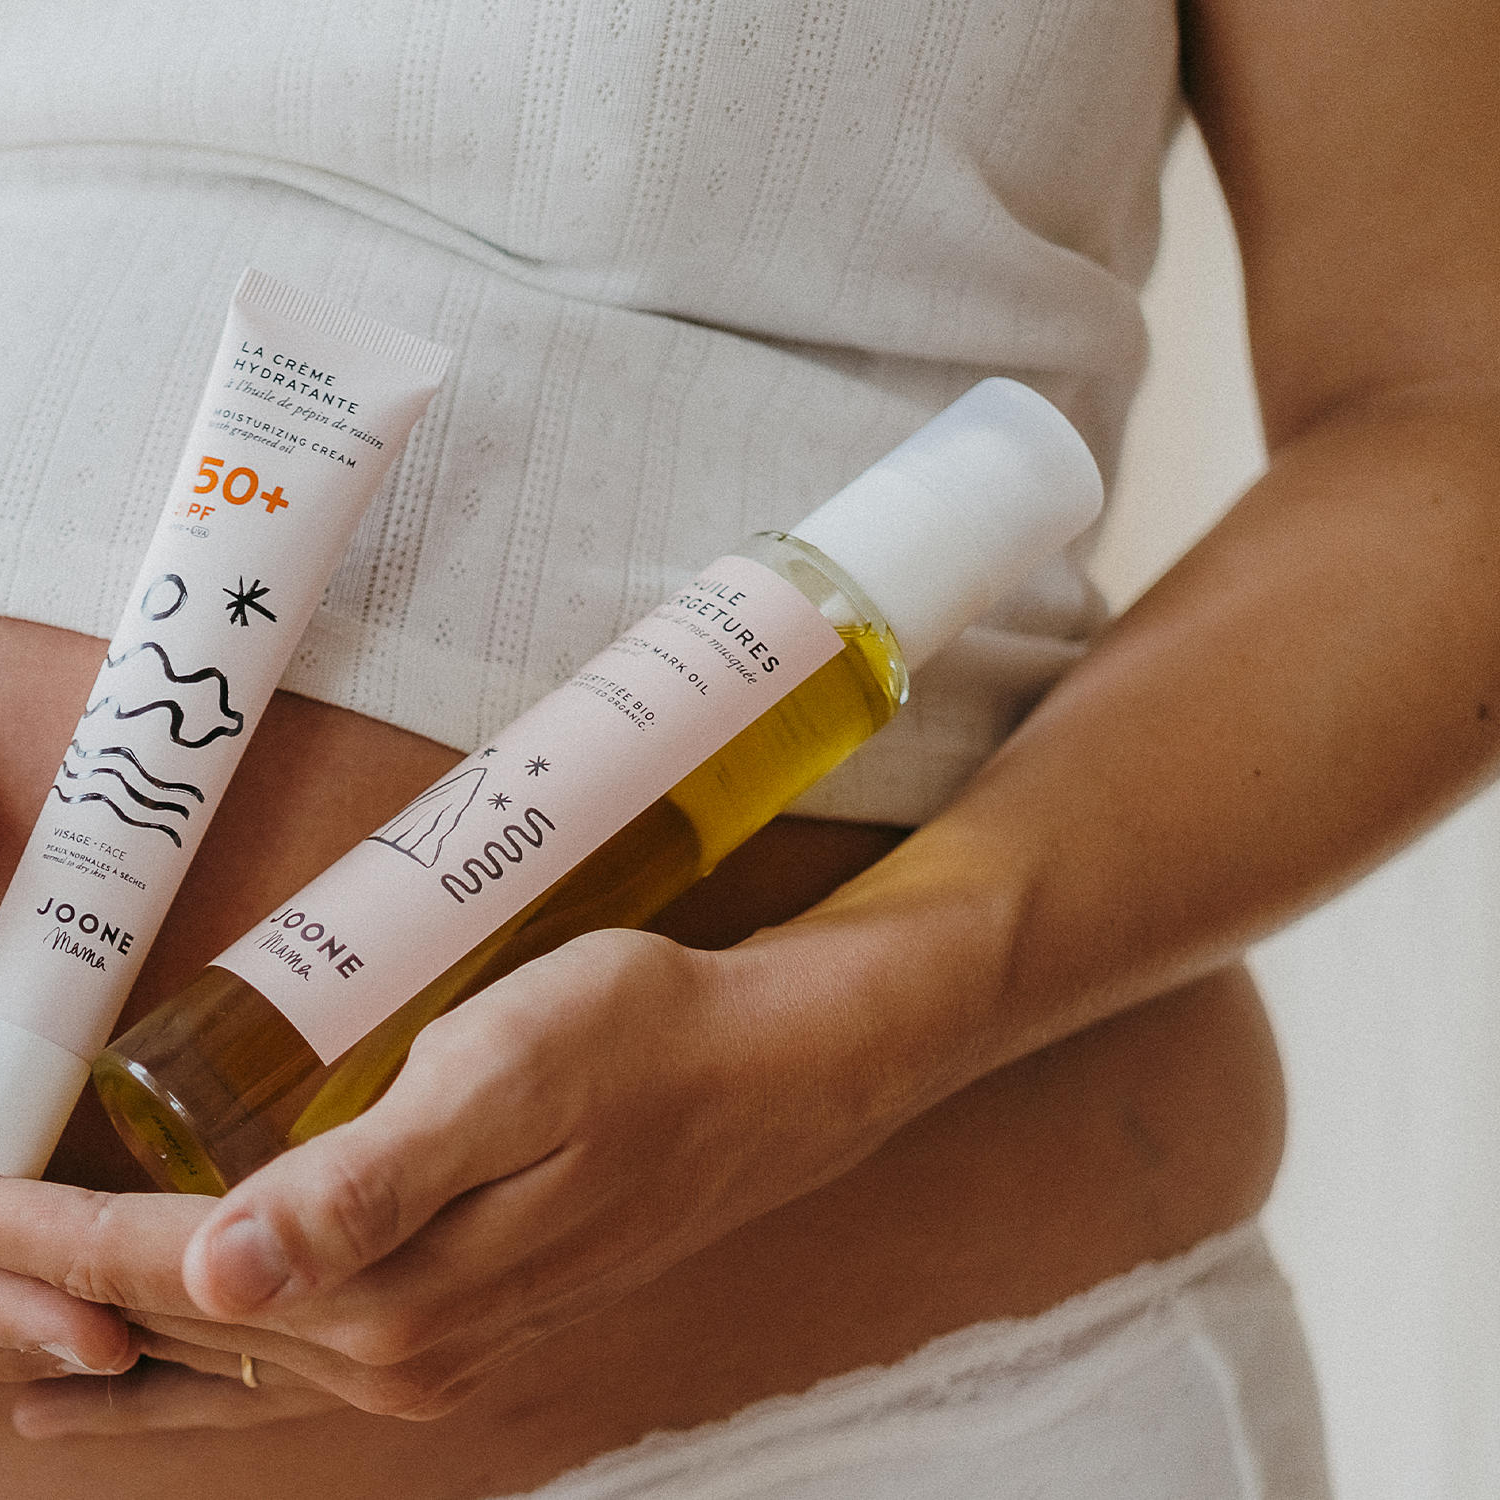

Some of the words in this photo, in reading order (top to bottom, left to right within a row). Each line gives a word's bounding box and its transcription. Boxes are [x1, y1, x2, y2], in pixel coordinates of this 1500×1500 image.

[233, 358, 359, 415] HYDRATANTE
[241, 341, 263, 358] LA
[273, 354, 336, 387] CRÈME
[213, 407, 307, 447] MOISTURIZING
[311, 443, 357, 469] CREAM
[235, 379, 276, 403] l'huile
[277, 397, 293, 410] de
[290, 405, 329, 426] pépin
[331, 418, 348, 431] de
[349, 427, 384, 450] raisin
[229, 426, 281, 449] grapeseed
[279, 444, 296, 455] oil
[188, 456, 290, 514] 50+
[652, 646, 688, 673] MARK
[688, 673, 709, 696] OIL
[686, 623, 710, 639] rose
[708, 638, 758, 685] musquée
[607, 697, 646, 732] ORGANIC.
[633, 701, 655, 726] BIO.
[42, 853, 66, 865] normal
[66, 858, 75, 867] to
[75, 861, 90, 875] dry
[90, 867, 106, 880] skin
[46, 844, 68, 855] PEAUX
[69, 850, 111, 872] NORMALES
[119, 871, 147, 891] SÈCHES
[54, 828, 92, 846] VISAGE
[100, 842, 128, 862] FACE
[37, 897, 134, 956] JOONE
[270, 908, 365, 980] JOONE
